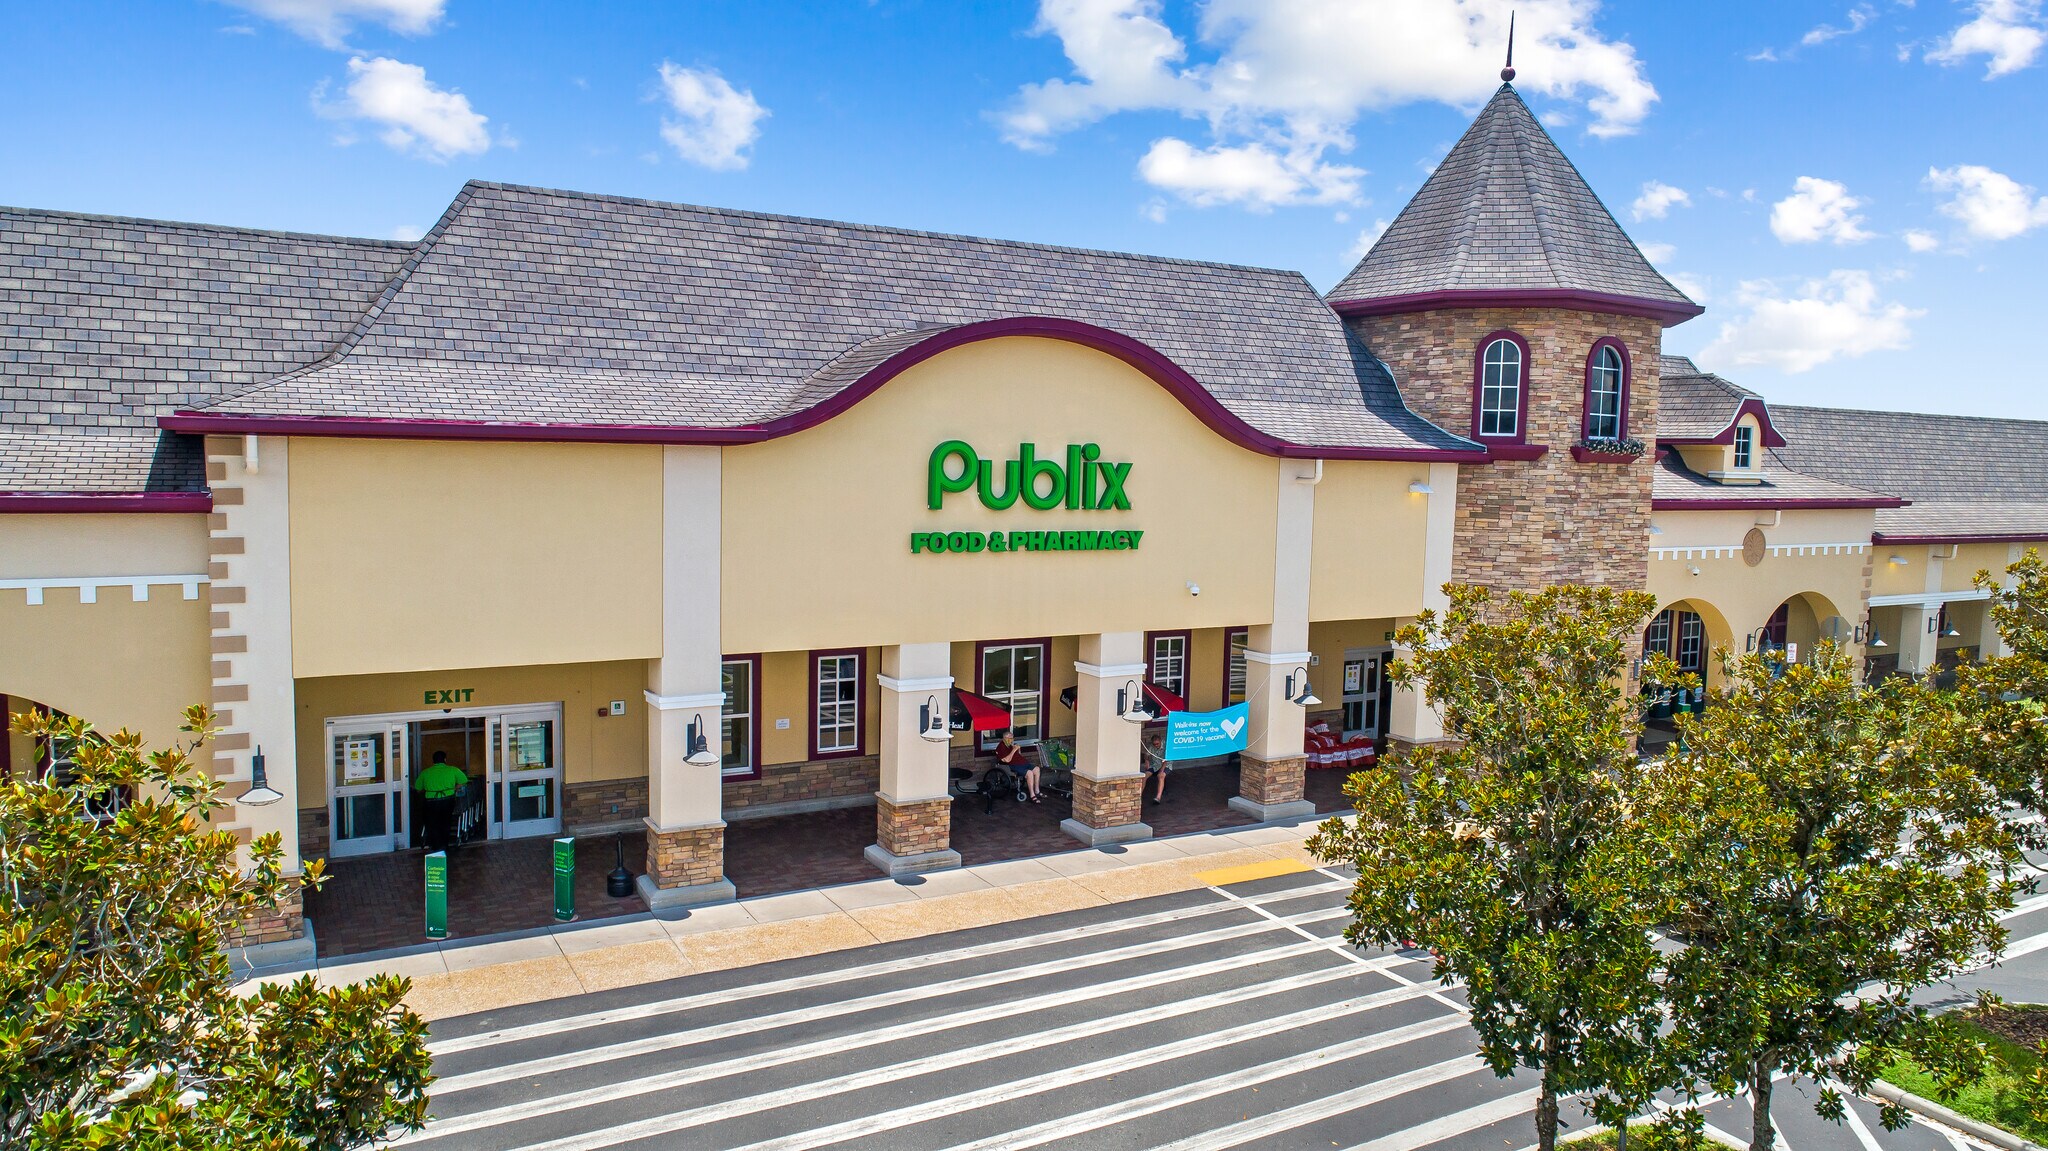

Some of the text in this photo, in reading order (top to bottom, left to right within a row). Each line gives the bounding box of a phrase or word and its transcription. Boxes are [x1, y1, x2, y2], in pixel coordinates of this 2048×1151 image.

[927, 439, 1134, 511] Publix
[910, 529, 1145, 554] FOOD & PHARMACY
[424, 688, 475, 705] EXIT
[1174, 733, 1226, 744] COVID-19 vaccine!
